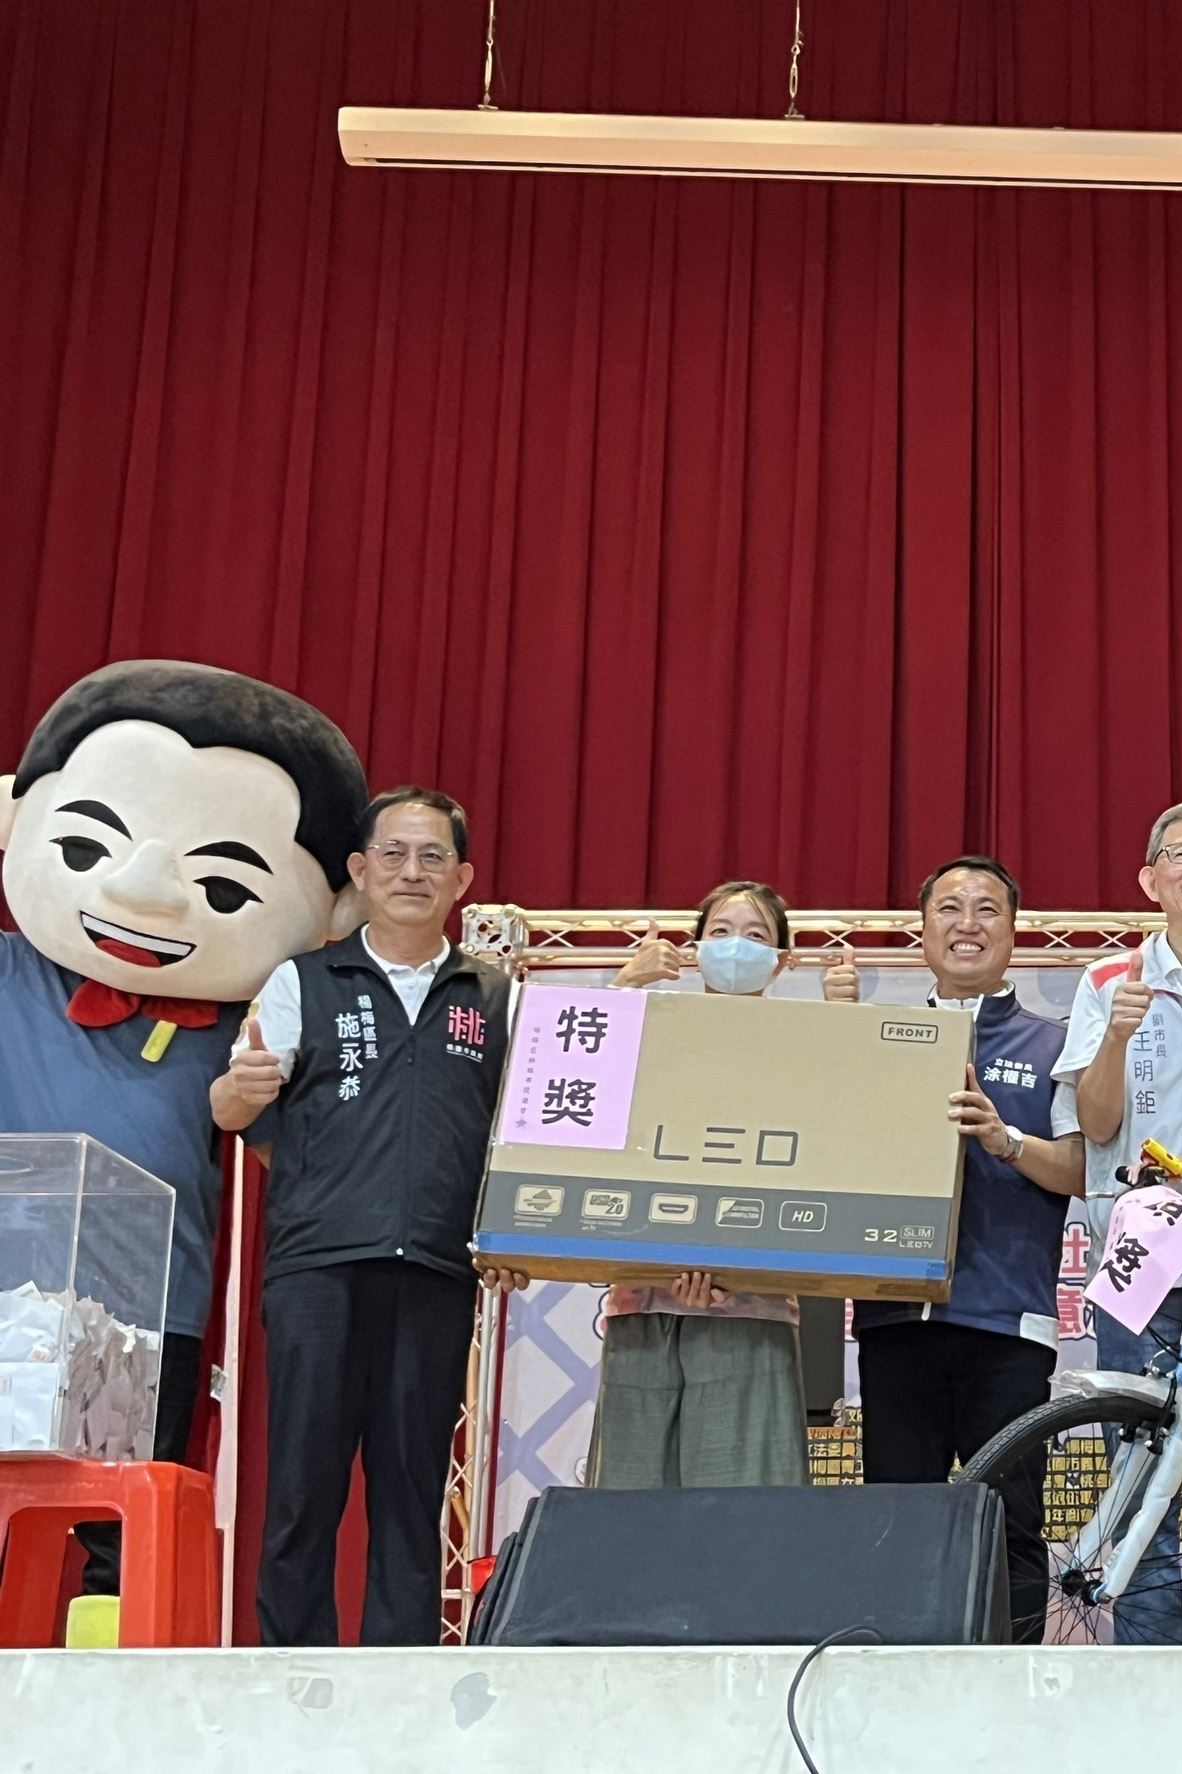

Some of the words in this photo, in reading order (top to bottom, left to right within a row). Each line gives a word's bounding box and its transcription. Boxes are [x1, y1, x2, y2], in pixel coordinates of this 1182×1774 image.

[887, 1026, 934, 1040] FRONT
[1152, 1013, 1167, 1058] 副市長
[541, 1005, 609, 1128] 特獎
[1133, 1030, 1156, 1115] 王明鉅
[654, 1124, 798, 1167] LED
[792, 1209, 814, 1224] HD
[864, 1228, 897, 1243] 32
[903, 1227, 932, 1239] SLIM
